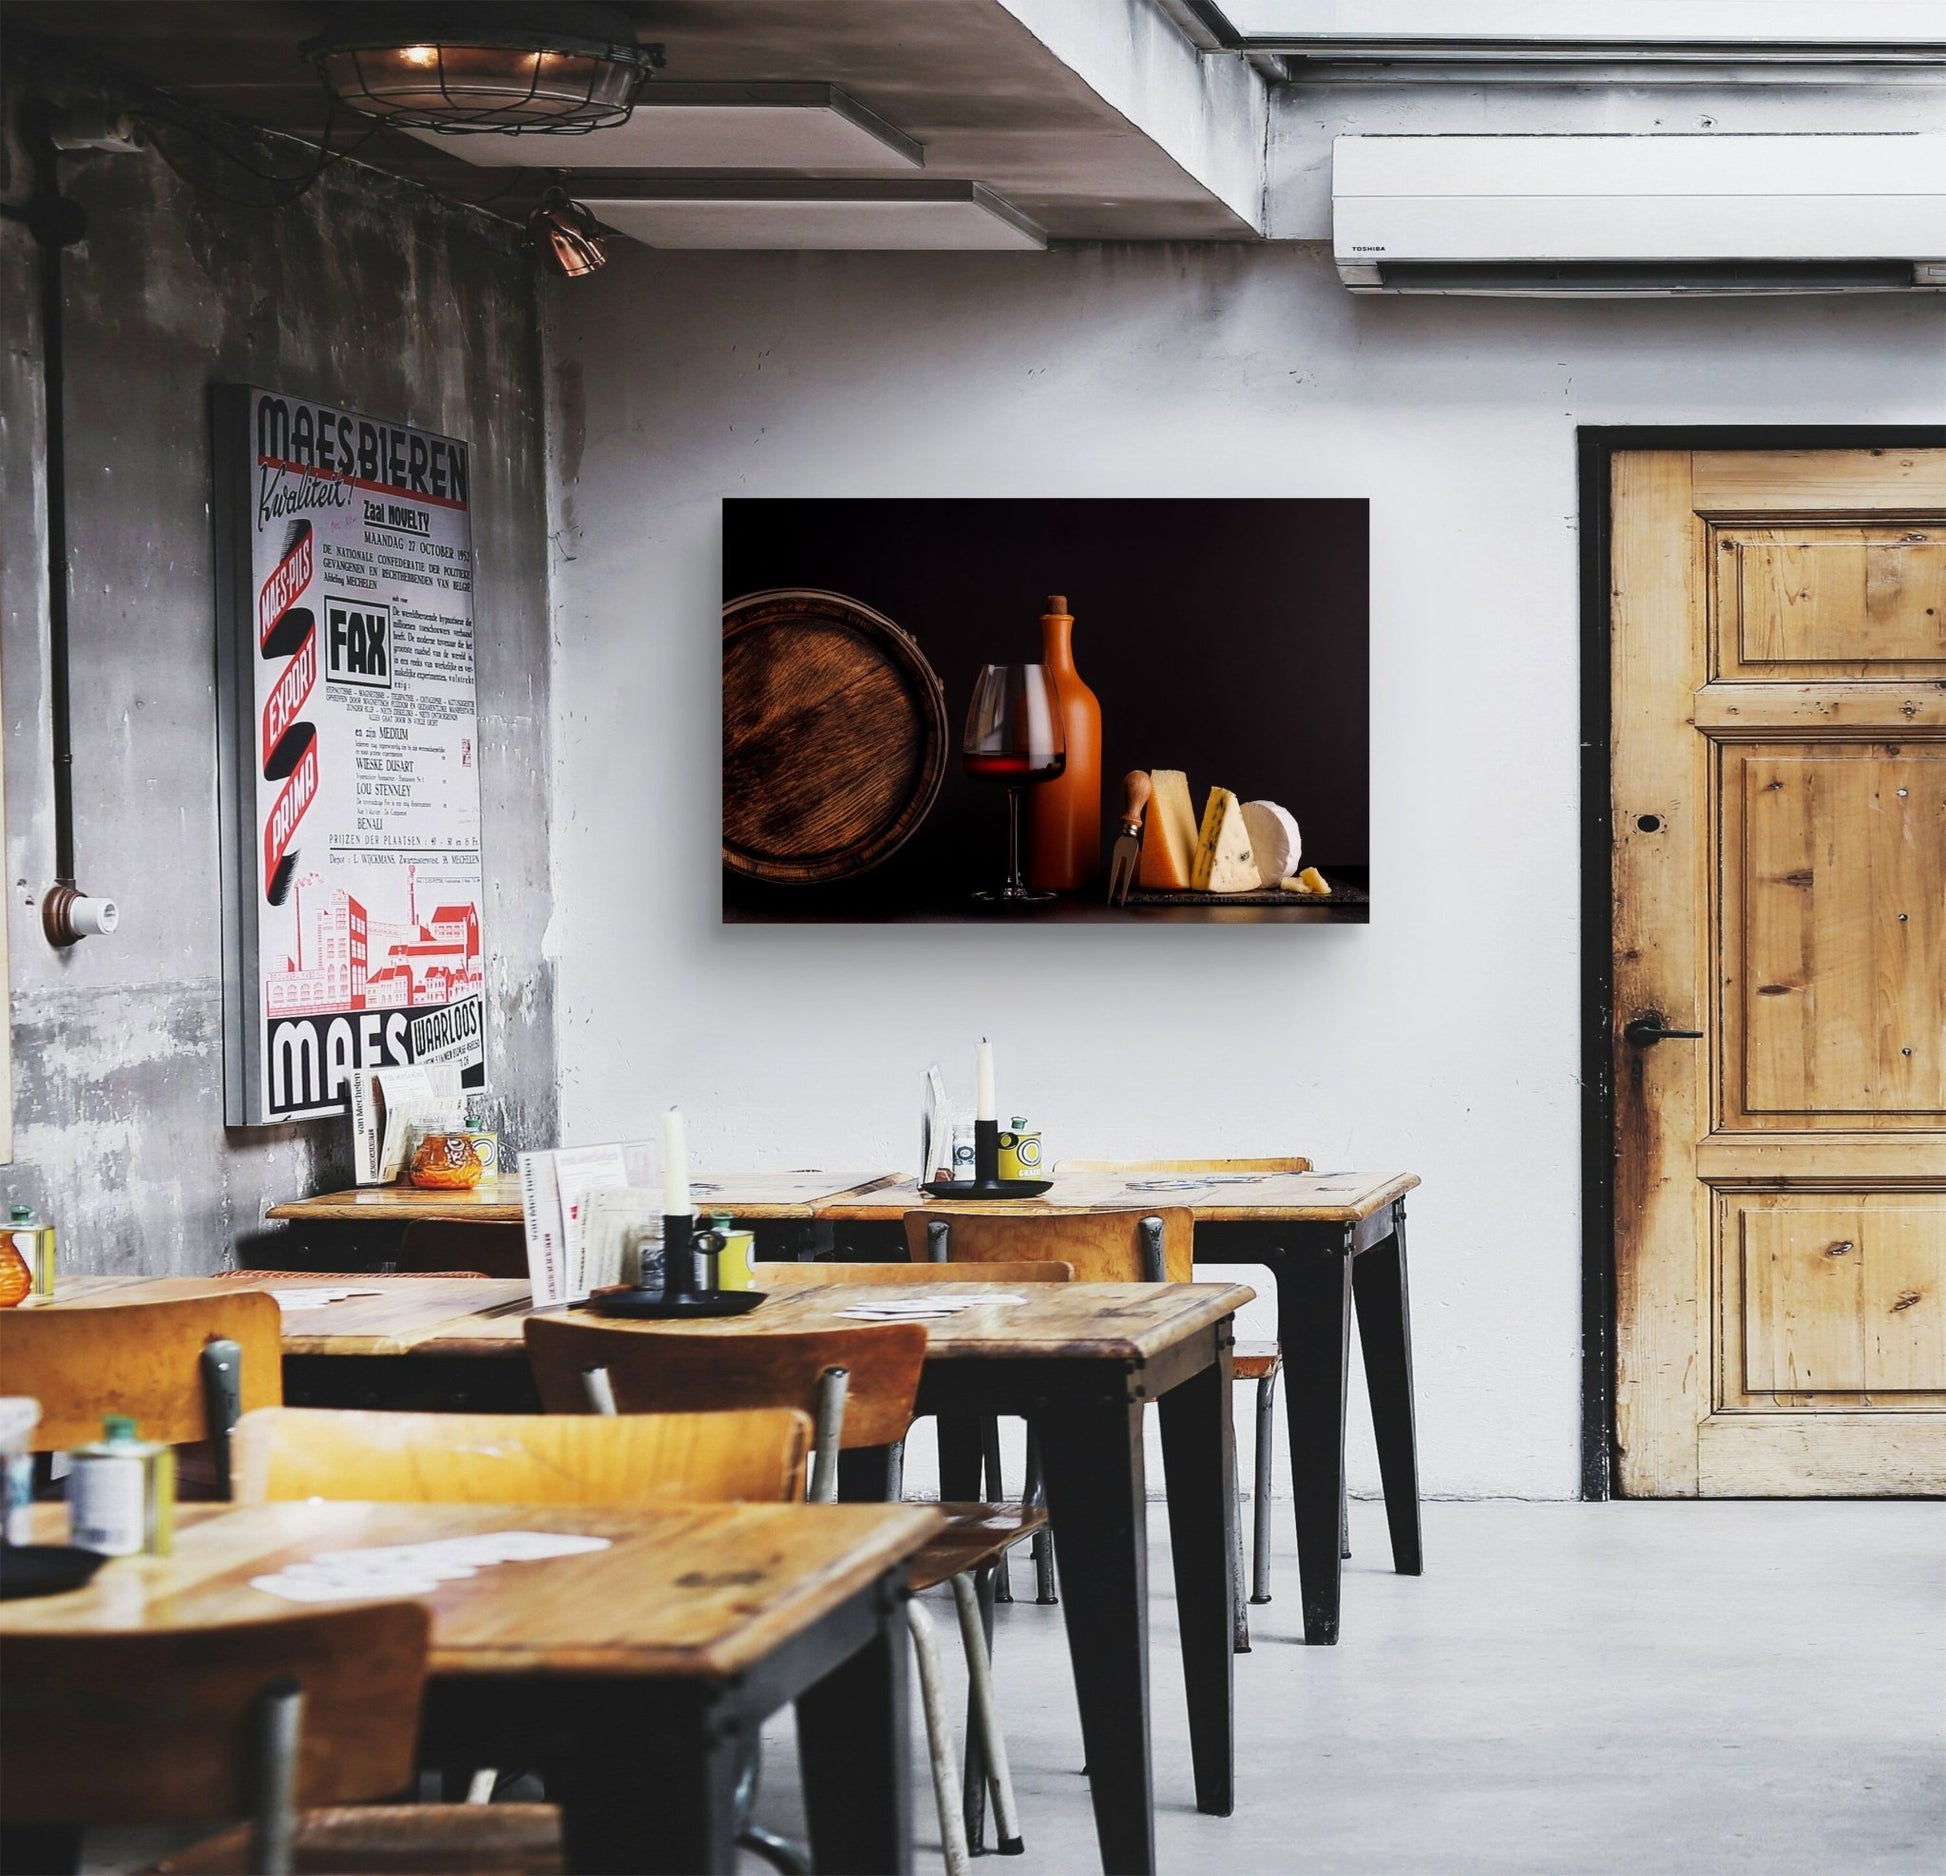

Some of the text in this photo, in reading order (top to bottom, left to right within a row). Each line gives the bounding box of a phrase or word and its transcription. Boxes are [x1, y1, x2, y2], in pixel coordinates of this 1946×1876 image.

[364, 500, 430, 532] Zaal NOVELTY
[364, 531, 404, 550] MAANDAG
[408, 540, 416, 551] 27
[420, 542, 454, 559] OCTOBER
[323, 544, 471, 580] DE NATIONALE CONFEDERATIE DER POLITIEKE
[323, 558, 365, 574] GEVANGENEN
[369, 566, 378, 577] EN
[382, 568, 433, 586] RECHTHEBBENDEN
[437, 578, 449, 588] VAN
[261, 543, 310, 639] MAES-PILS
[346, 575, 378, 590] MECHELEN
[329, 608, 387, 677] FAX
[269, 637, 316, 740] EXPORT
[379, 727, 408, 741] MEDIUM
[356, 758, 414, 773] WIESKE DUSART
[356, 782, 372, 795] LOU
[272, 752, 314, 858] PRIMA
[329, 834, 361, 846] PRIJZEN
[365, 835, 379, 845] DER
[384, 835, 421, 846] PLAATSEN
[357, 818, 383, 830] BENALI
[413, 1001, 478, 1056] WAARLOOS
[272, 1012, 410, 1108] MAES
[353, 1072, 363, 1117] Mechelen
